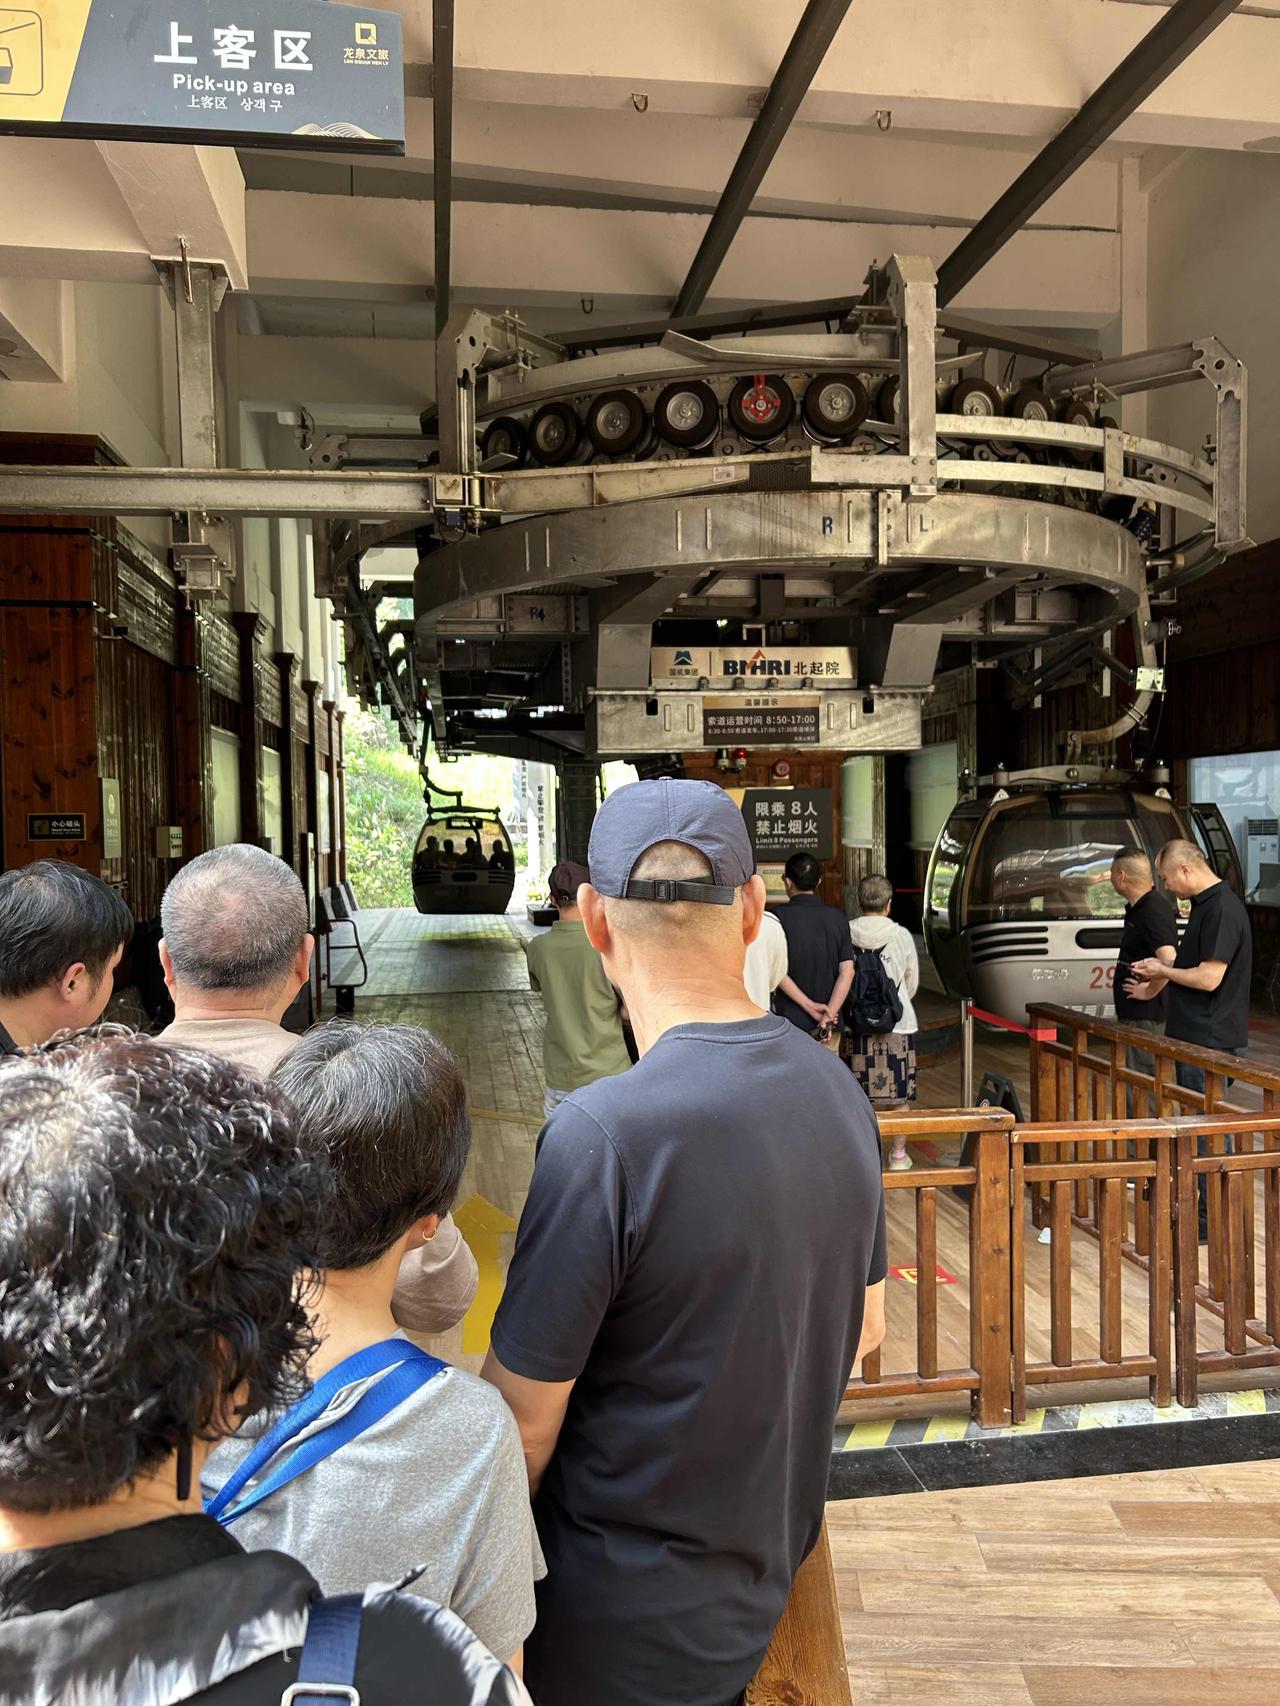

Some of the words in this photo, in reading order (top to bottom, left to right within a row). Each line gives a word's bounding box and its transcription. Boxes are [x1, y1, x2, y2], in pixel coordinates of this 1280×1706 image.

[154, 21, 313, 71] 上客区
[343, 47, 389, 60] 龙泉文旅
[173, 73, 249, 96] Pick-up
[253, 81, 296, 96] area
[188, 94, 228, 110] 上客区
[822, 516, 833, 535] R
[793, 660, 840, 676] 北起院
[707, 715, 763, 726] 索道运营时间
[765, 714, 816, 725] 8:50-17:00
[755, 819, 819, 836] 禁止烟火
